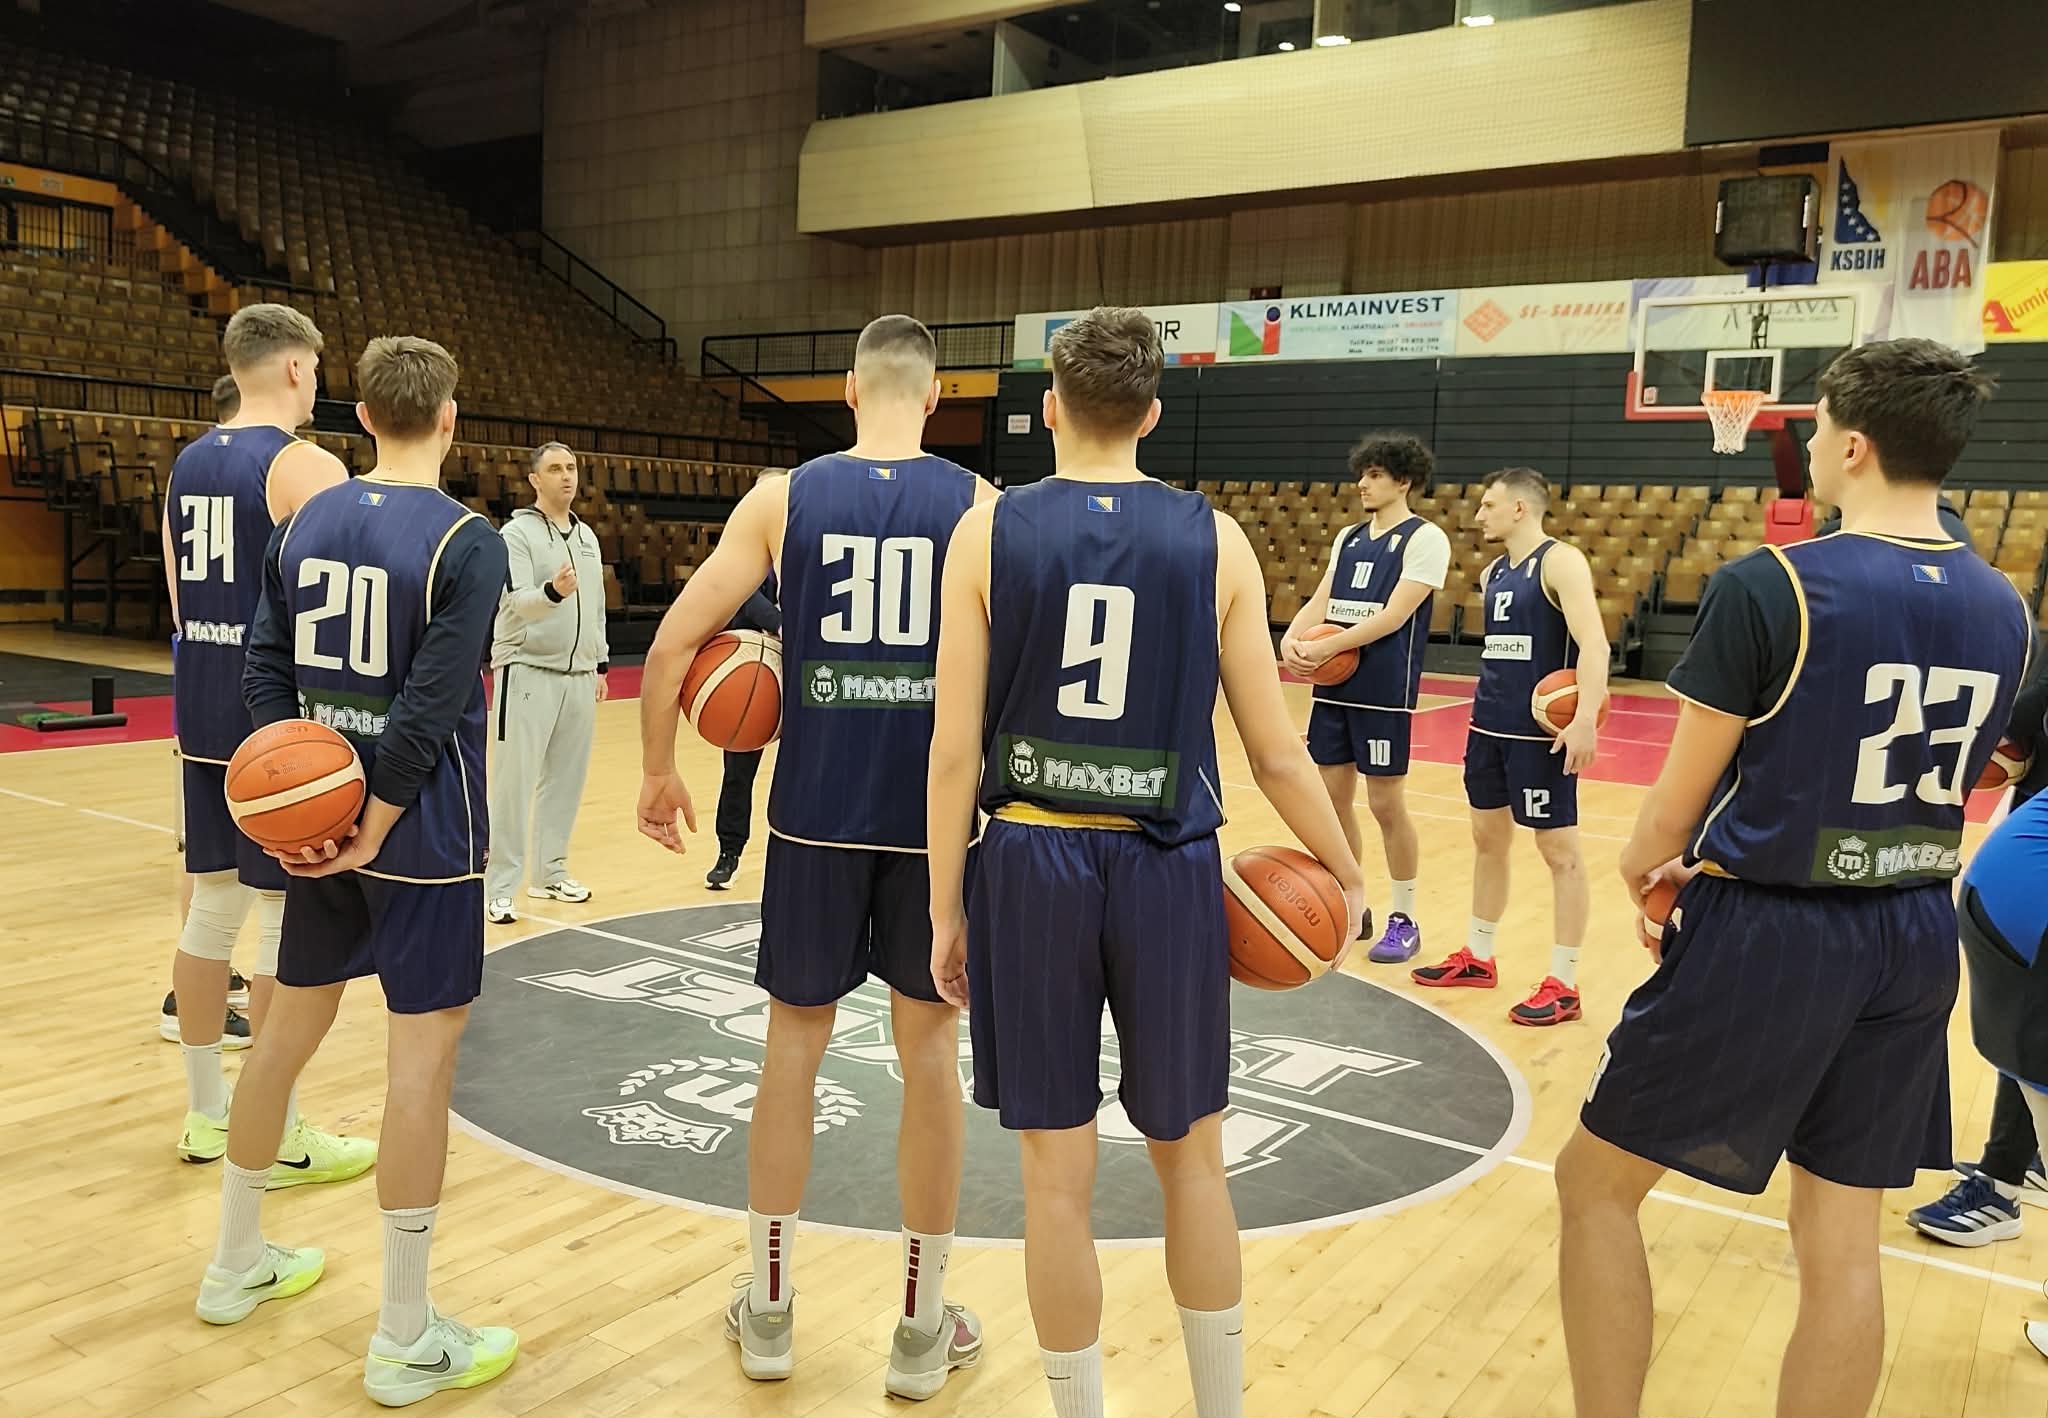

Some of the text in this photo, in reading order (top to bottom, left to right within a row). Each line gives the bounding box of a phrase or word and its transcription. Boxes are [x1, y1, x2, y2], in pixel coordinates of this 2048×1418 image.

[1831, 248, 1885, 270] KSBIH
[1909, 249, 1972, 289] ABA
[1290, 297, 1445, 319] KLIMAINVEST
[180, 495, 234, 583] 34
[821, 533, 934, 646] 30
[1350, 561, 1374, 589] 10
[295, 557, 388, 677] 20
[1493, 591, 1514, 621] 12
[1056, 583, 1136, 720] 9
[313, 703, 390, 736] MAXBE
[1851, 663, 2000, 806] 23
[1367, 739, 1391, 766] 10
[1523, 788, 1552, 818] 12
